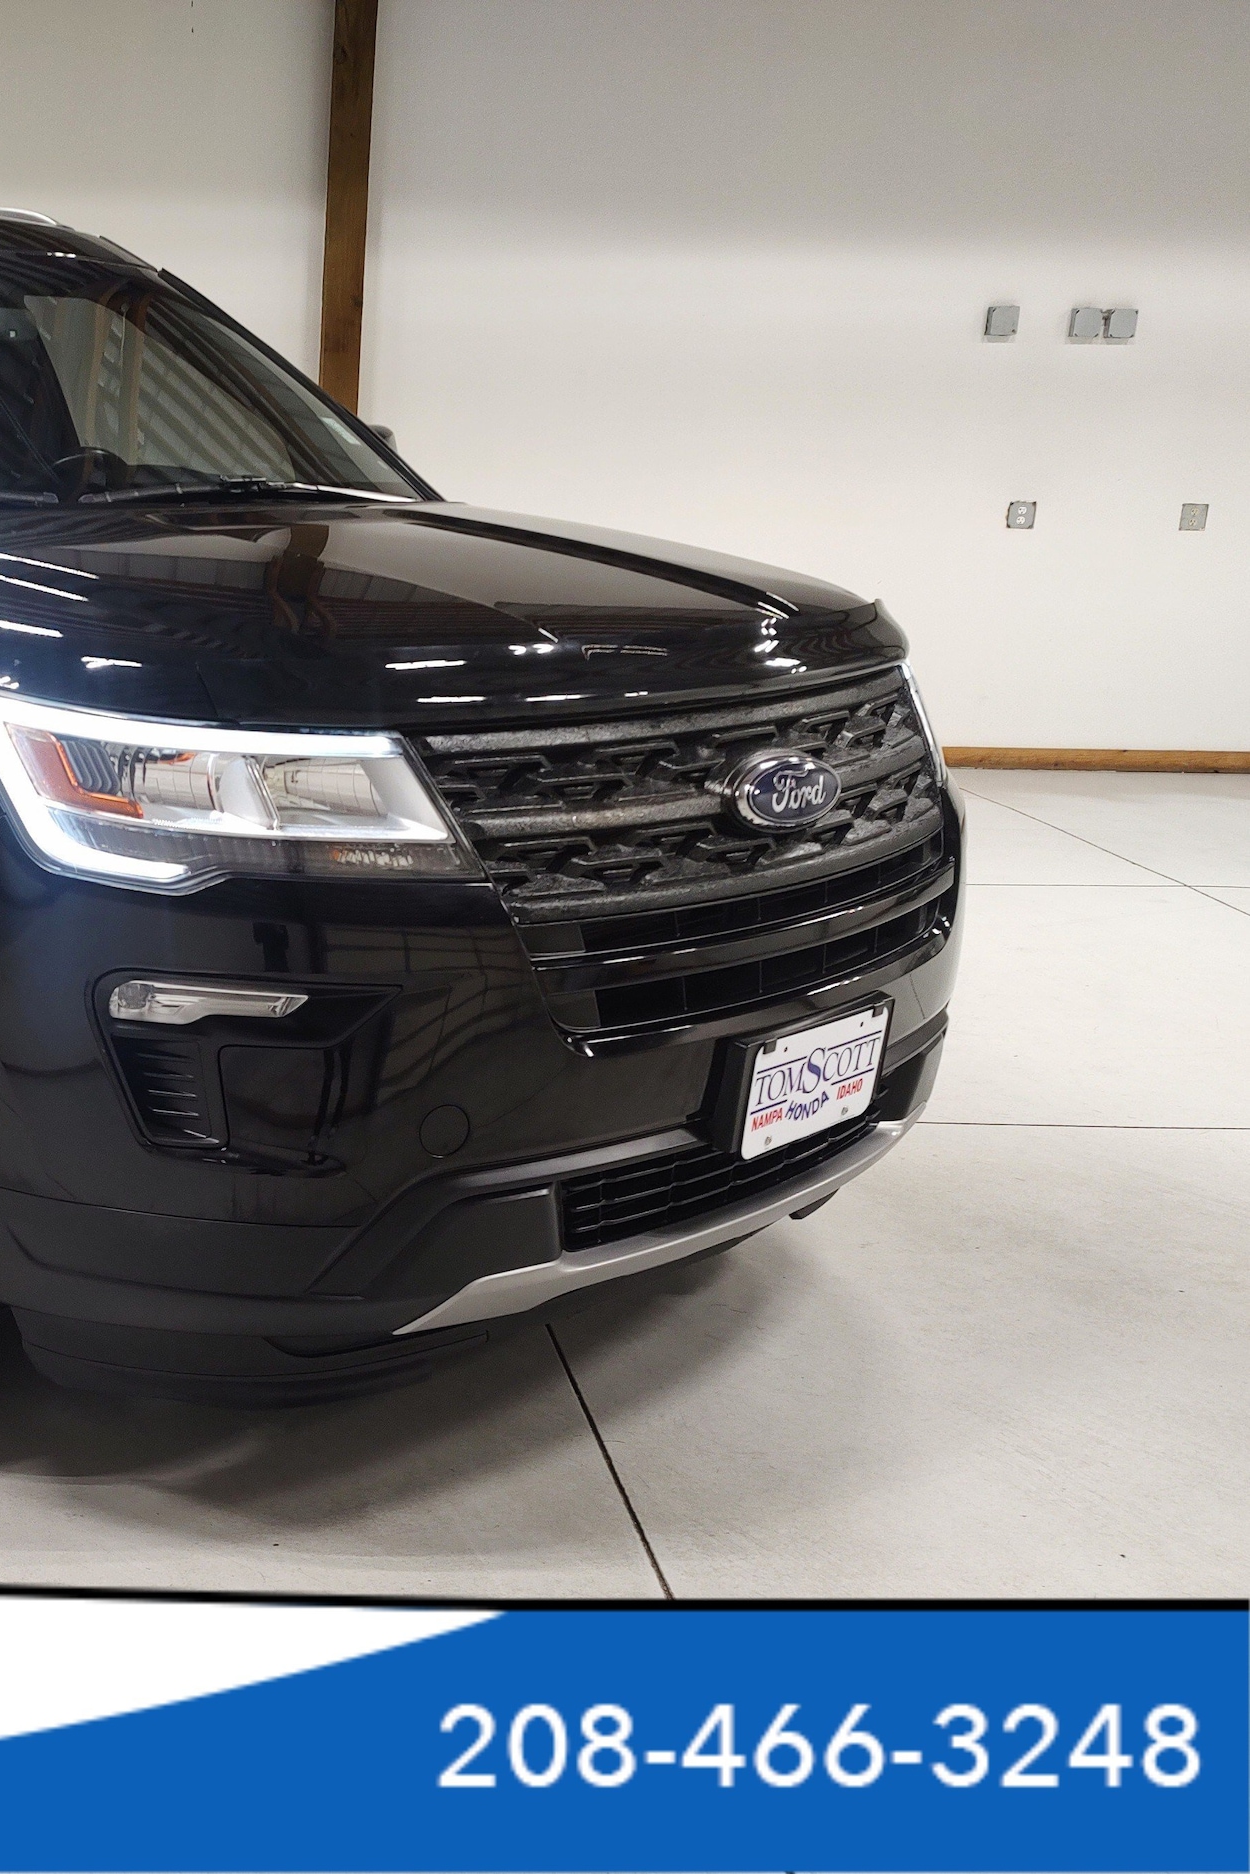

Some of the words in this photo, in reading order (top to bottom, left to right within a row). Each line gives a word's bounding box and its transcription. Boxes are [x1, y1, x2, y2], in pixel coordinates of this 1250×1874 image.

[772, 769, 826, 813] Ford
[751, 1107, 783, 1132] NAMPA
[785, 1090, 830, 1121] HONDA
[836, 1078, 863, 1100] IDAHO
